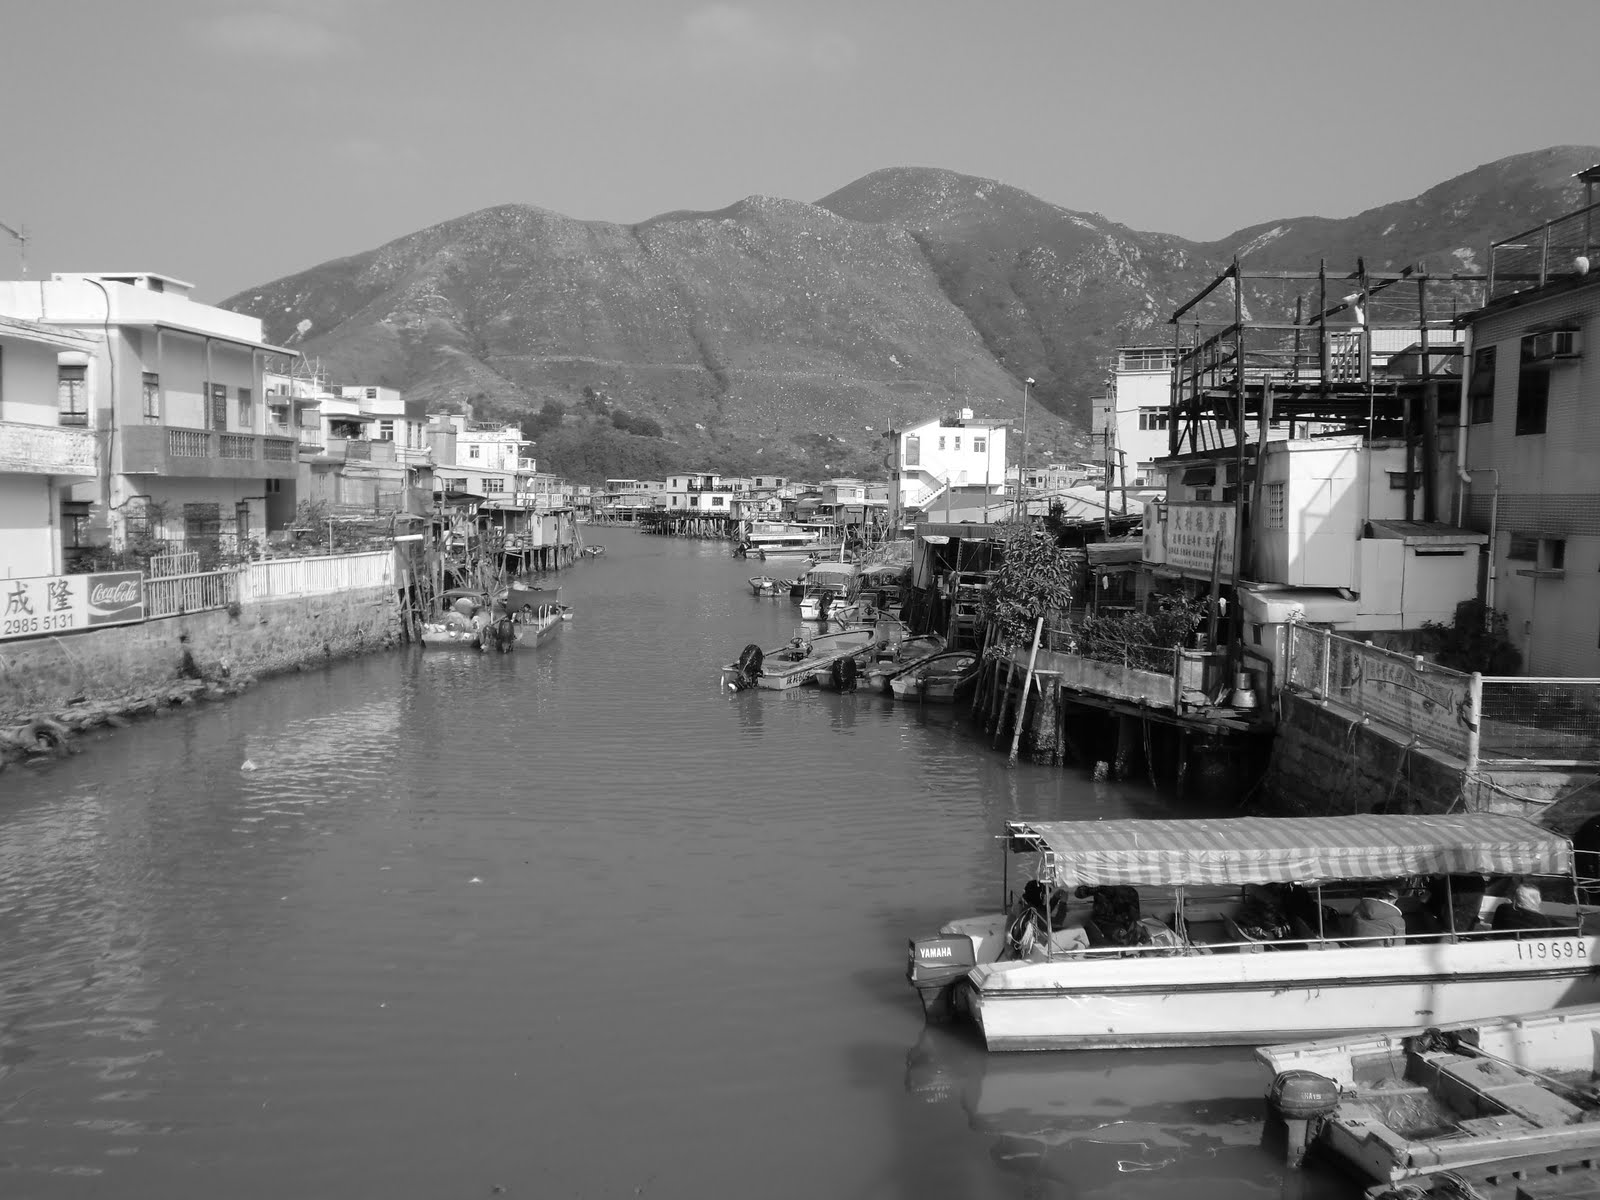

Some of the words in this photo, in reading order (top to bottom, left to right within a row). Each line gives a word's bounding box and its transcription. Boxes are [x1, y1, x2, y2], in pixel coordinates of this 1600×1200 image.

[4, 578, 74, 616] 成隆
[4, 617, 38, 635] 2985
[43, 613, 74, 630] 5131
[920, 947, 952, 958] YAMAHA
[1517, 941, 1587, 960] 119698
